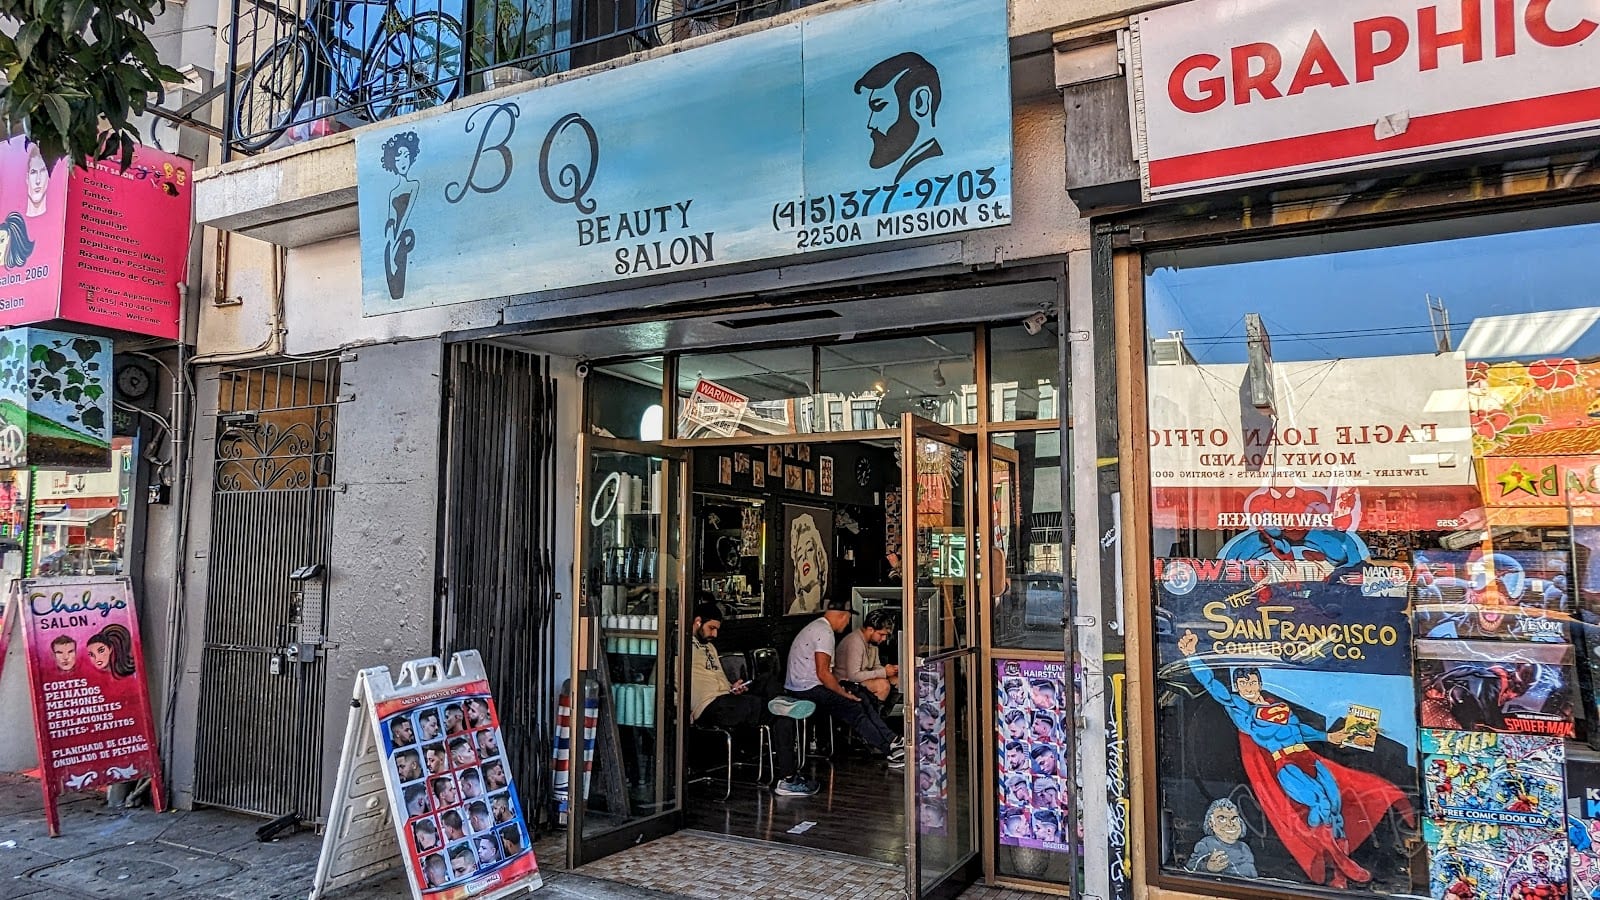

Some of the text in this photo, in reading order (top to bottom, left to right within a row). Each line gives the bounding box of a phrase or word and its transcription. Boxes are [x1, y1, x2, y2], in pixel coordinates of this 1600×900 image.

[1167, 0, 1600, 114] GRAPHIC
[83, 177, 115, 192] Cortes
[83, 189, 112, 203] Tintes
[773, 167, 996, 230] (415)377-9703
[82, 201, 124, 217] Peinados
[81, 213, 128, 231] Maquillaje
[577, 200, 693, 246] BEAUTY
[797, 224, 861, 248] 2250A
[877, 206, 968, 237] MISSION
[80, 225, 140, 245] Permanentes
[79, 249, 110, 262] Rizado
[112, 257, 124, 265] De
[80, 237, 164, 263] Depilaciones (Wax)
[615, 232, 714, 274] SALON
[78, 261, 166, 287] Planchado de Cejas
[79, 282, 172, 306] Make Your Appointment
[96, 296, 117, 307] (415)
[126, 313, 161, 324] Welcome
[700, 382, 742, 408] WARNING
[1363, 567, 1404, 579] MARVEL
[30, 590, 127, 617] Chely's
[1225, 588, 1252, 608] the
[1519, 617, 1564, 635] VENOM
[43, 678, 88, 691] CORTES
[45, 686, 101, 701] PEINADOS
[46, 695, 105, 711] MECHONES
[47, 702, 122, 720] PERMANENTES
[48, 713, 114, 730] DEPILACIONES
[1504, 717, 1574, 735] SPIDER-MAN
[52, 742, 104, 758] PLANCHADO
[106, 739, 117, 748] DE
[53, 753, 98, 768] ONDULADO
[100, 749, 111, 759] DE
[1443, 808, 1549, 825] FREE COMIC BOOK DAY
